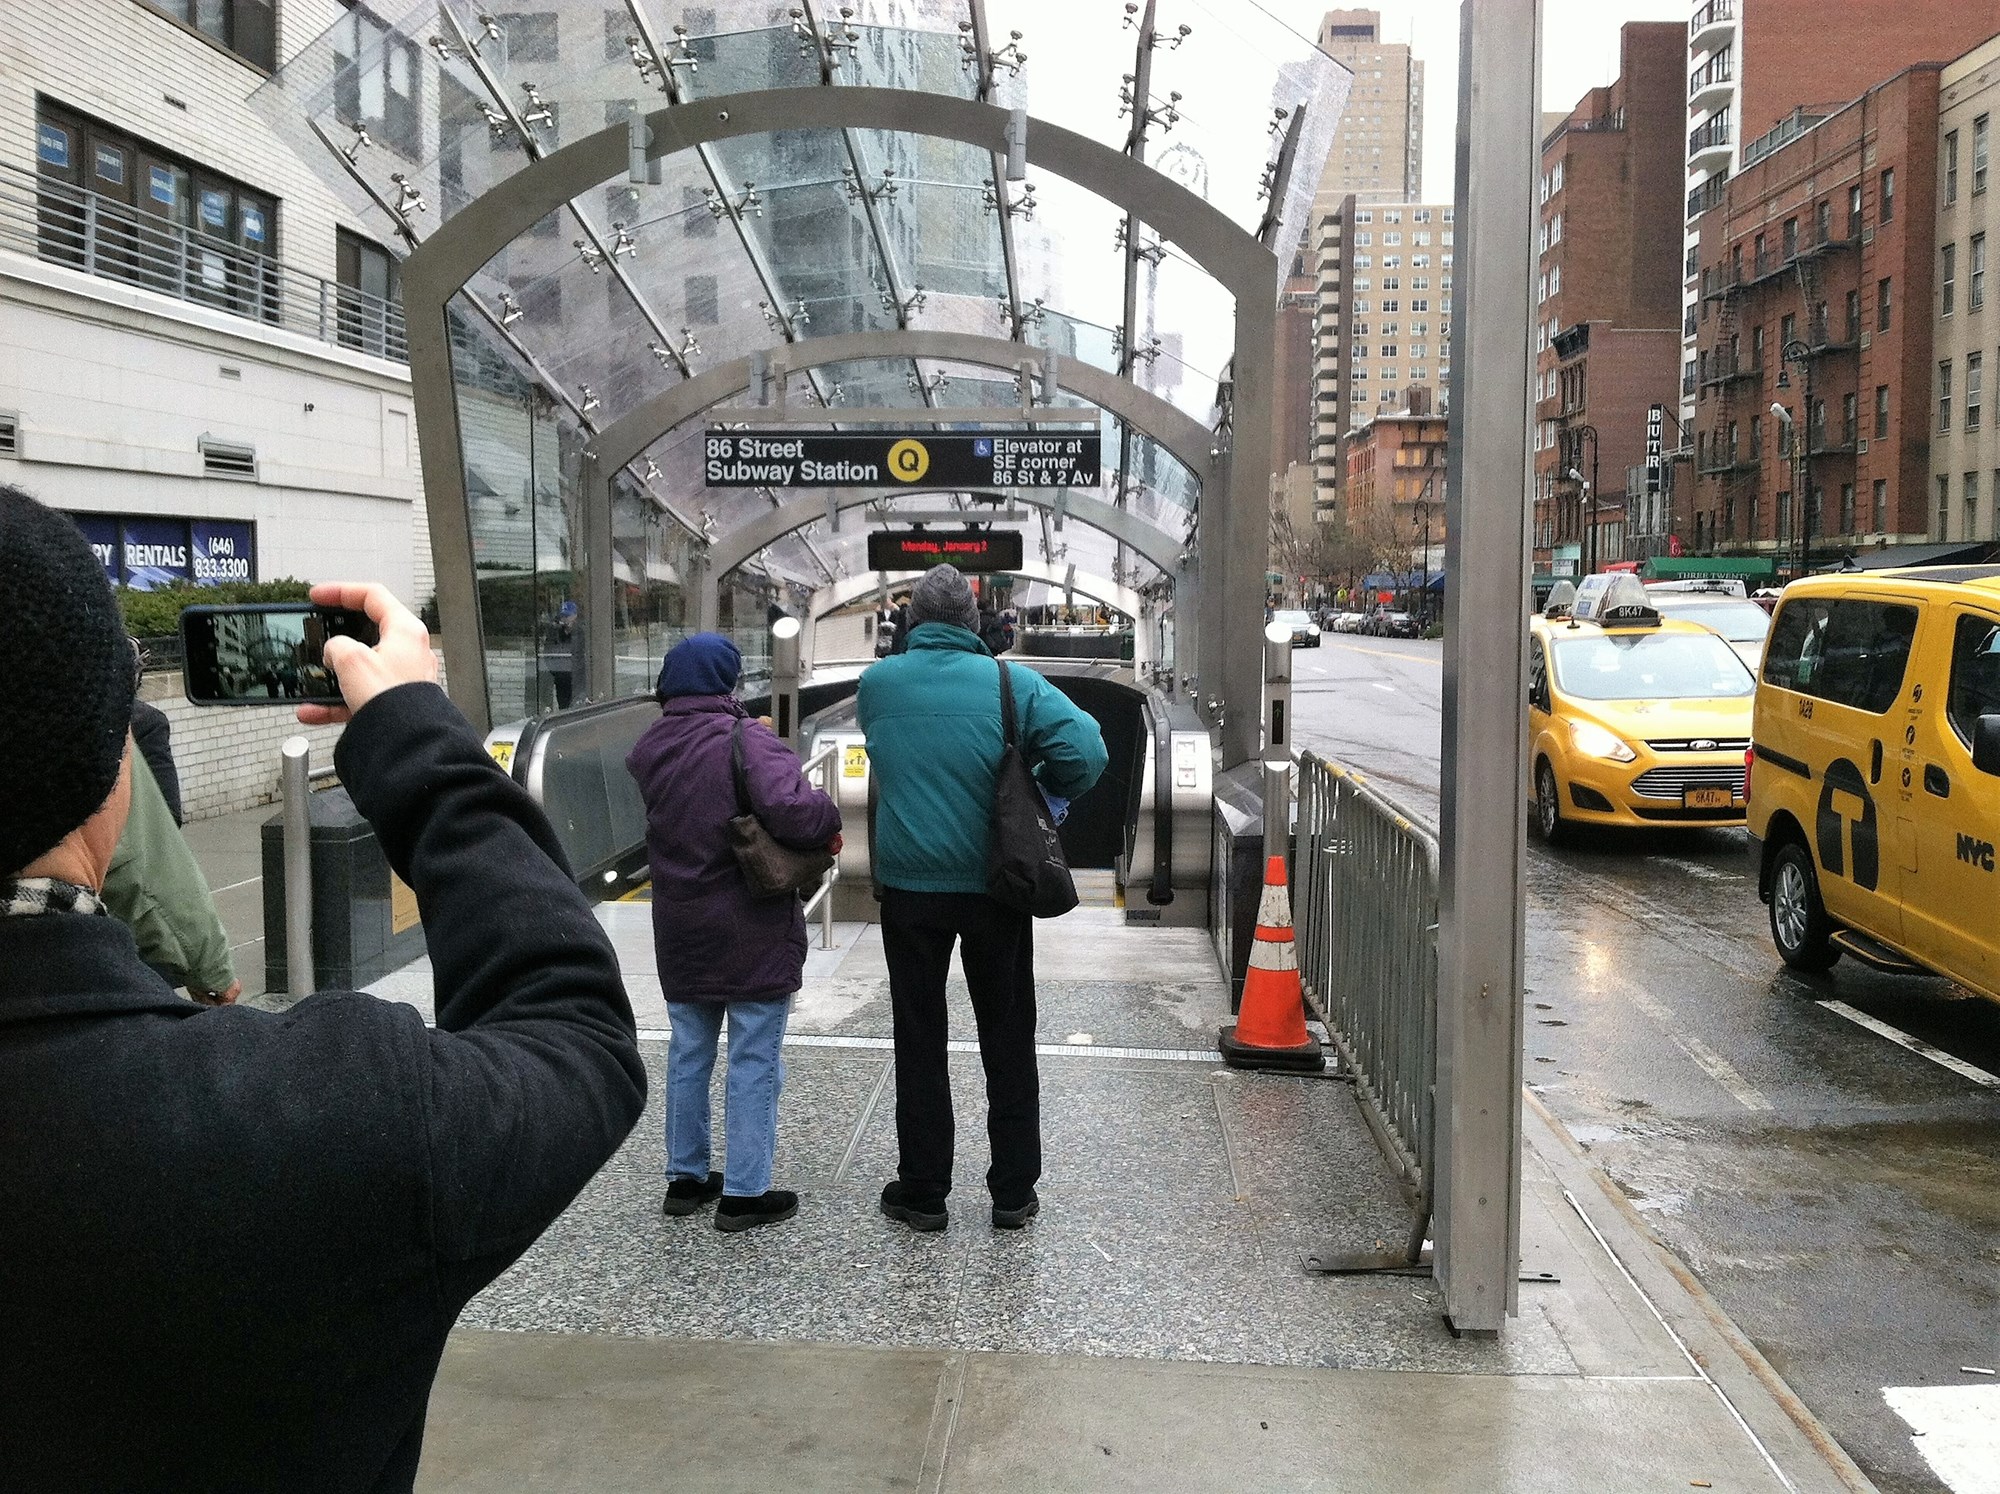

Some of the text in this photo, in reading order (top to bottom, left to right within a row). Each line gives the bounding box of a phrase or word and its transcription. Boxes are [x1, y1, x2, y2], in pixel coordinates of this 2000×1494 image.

[706, 437, 805, 459] 86 Street
[993, 438, 1083, 454] Elevator at
[897, 447, 920, 473] Q
[993, 454, 1076, 470] SE corner
[706, 459, 878, 486] Subway Station
[993, 470, 1094, 486] 86 St & 2 Av
[125, 543, 187, 567] RENTALS
[208, 536, 234, 557] (646)
[943, 540, 980, 553] January
[195, 557, 249, 578] 833.3300
[1677, 571, 1751, 581] THREE TWENTY
[1618, 606, 1643, 617] 8K47
[1956, 832, 1996, 873] NYC
